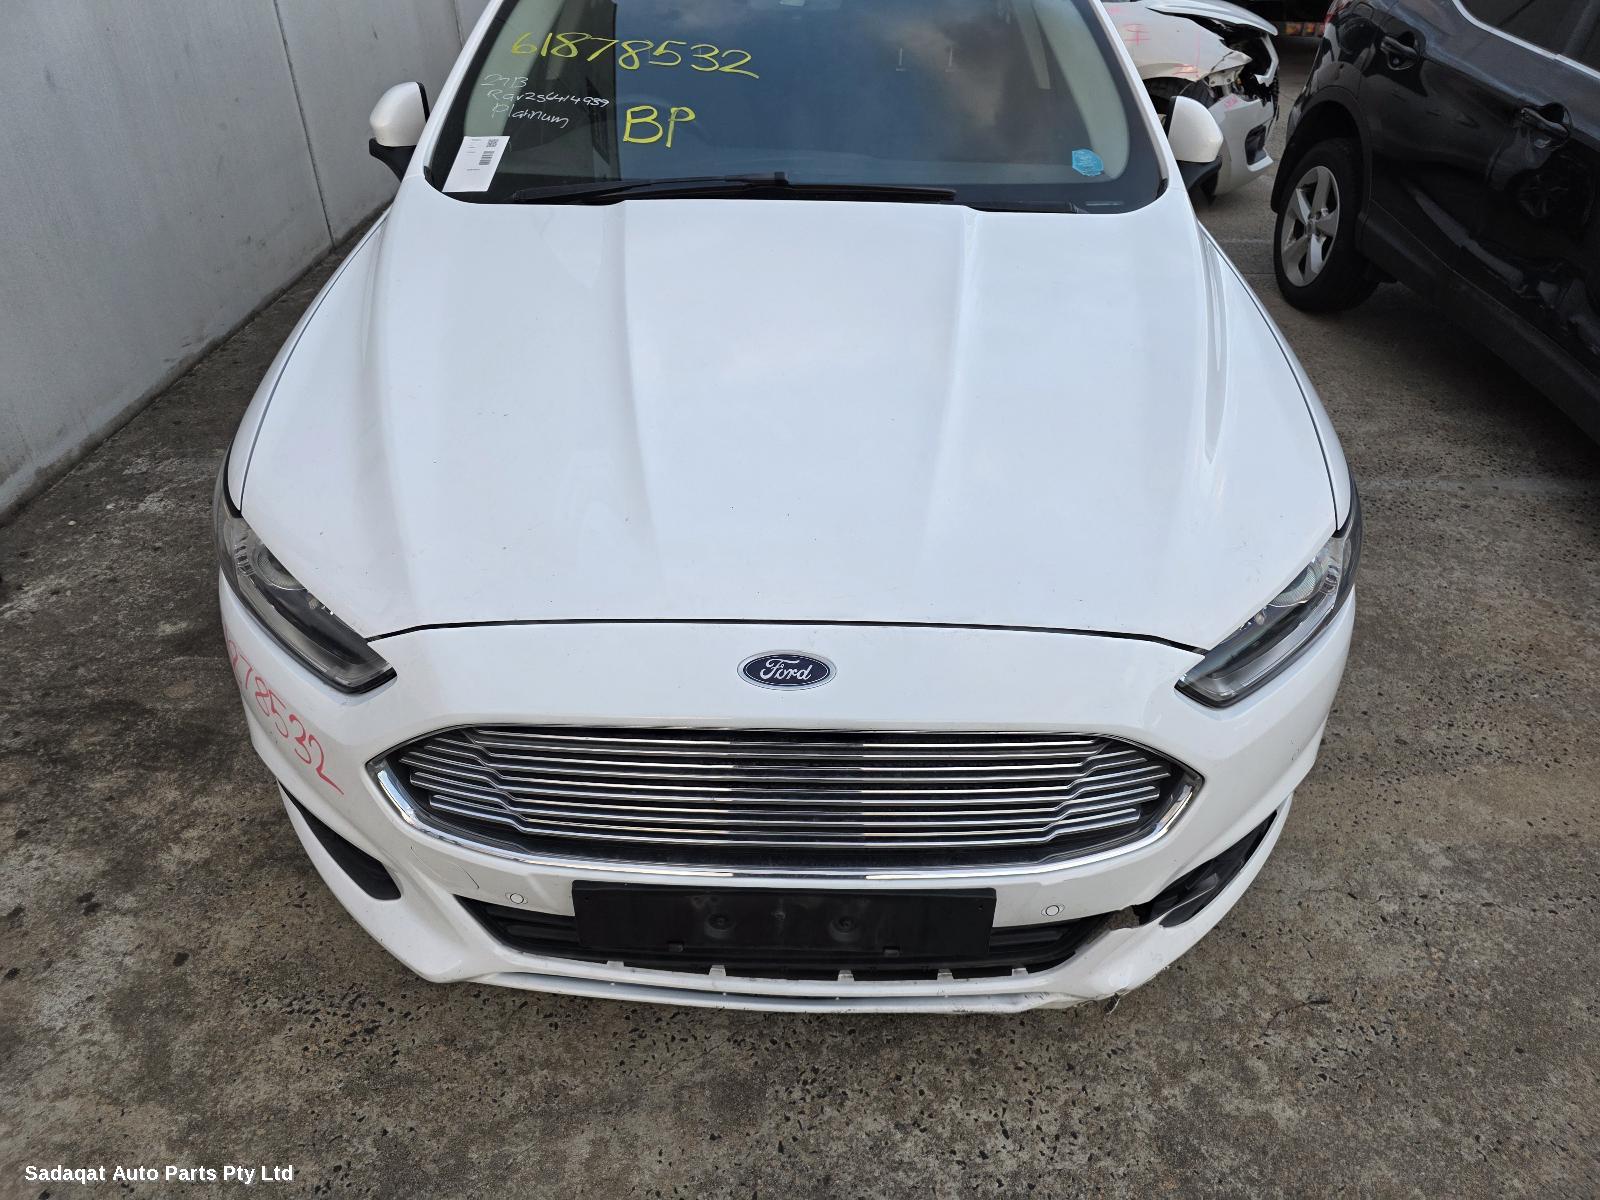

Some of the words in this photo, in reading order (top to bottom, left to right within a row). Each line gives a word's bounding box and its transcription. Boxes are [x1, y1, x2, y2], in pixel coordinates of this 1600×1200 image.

[511, 32, 759, 79] 61878532
[623, 105, 696, 148] BP
[760, 658, 813, 680] Ford
